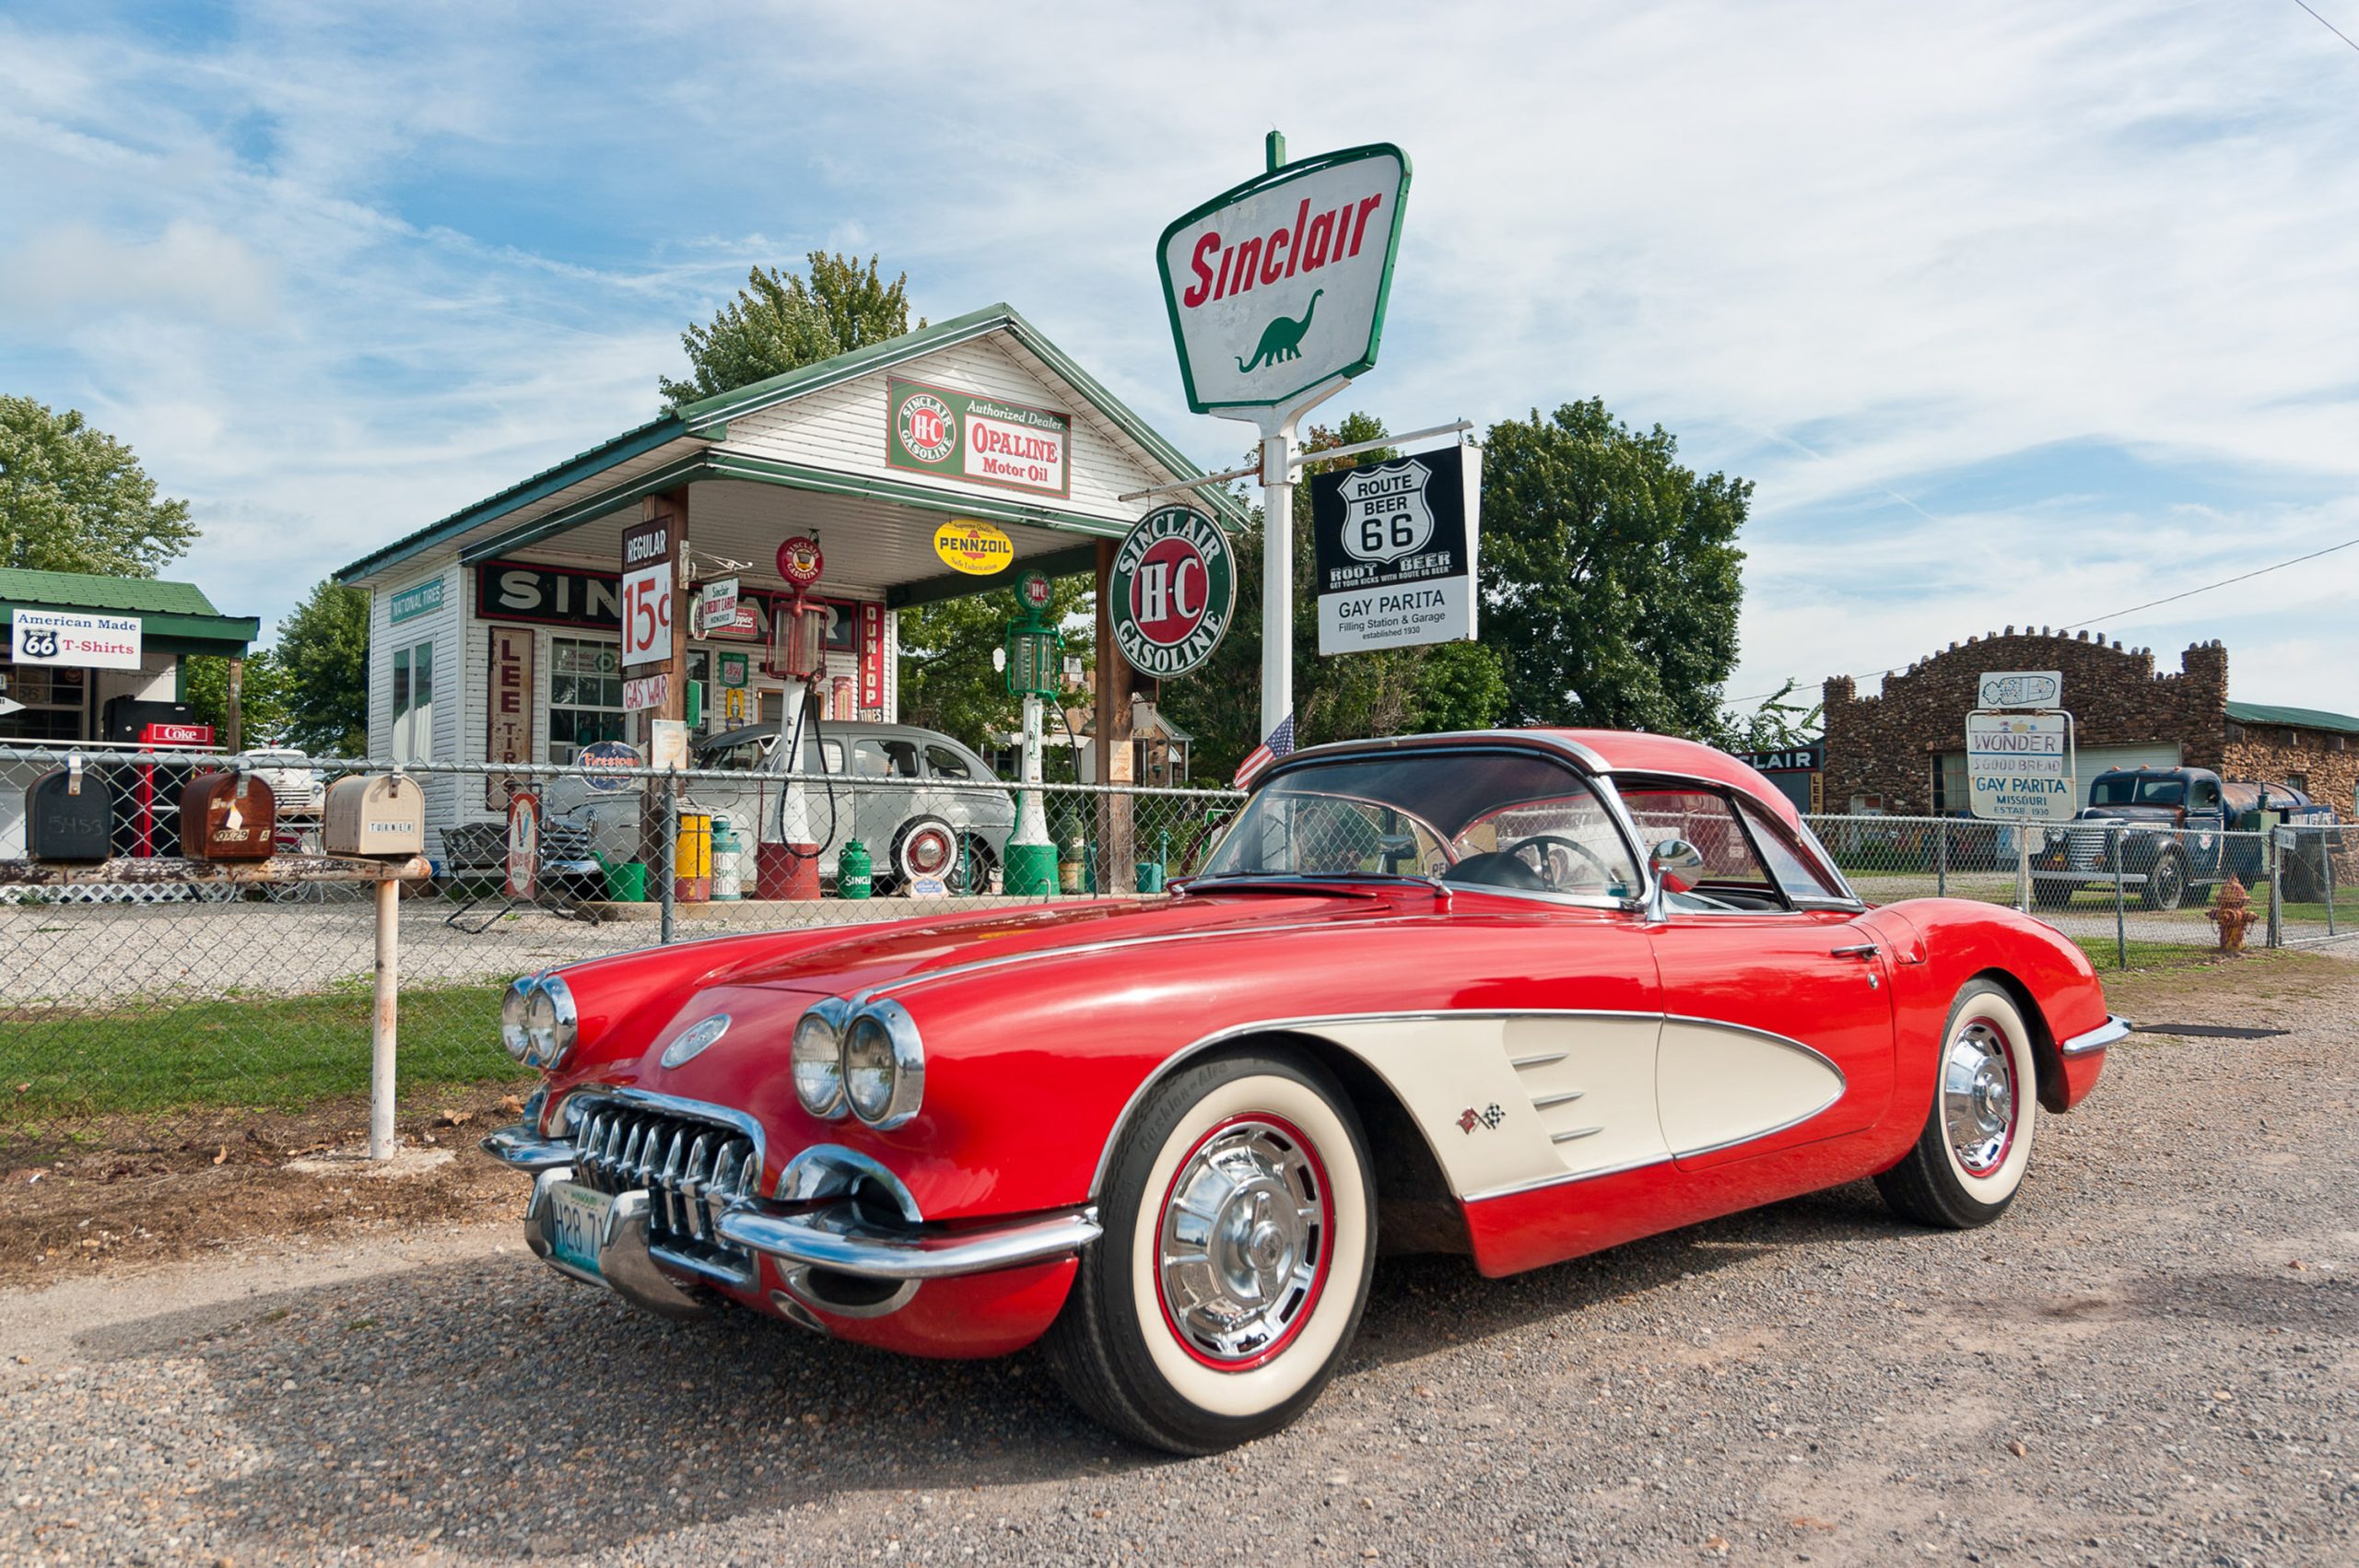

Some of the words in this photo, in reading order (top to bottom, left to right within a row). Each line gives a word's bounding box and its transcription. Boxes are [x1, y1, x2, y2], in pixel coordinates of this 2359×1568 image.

[1183, 193, 1382, 308] Sinclair
[902, 394, 953, 427] SINCLAIR
[967, 400, 1026, 424] Authorized
[1027, 412, 1062, 430] Dealer
[901, 428, 953, 460] GASOLINE
[972, 422, 1058, 464] OPALINE
[982, 457, 1026, 478] Motor
[1027, 465, 1049, 482] Oil
[1357, 474, 1413, 497] ROUTE
[1364, 497, 1408, 516] BEER
[1360, 513, 1414, 552] 66
[628, 529, 666, 564] REGULAR
[786, 542, 820, 559] SINCLAIR
[939, 537, 1010, 554] PENNZOIL
[1118, 512, 1221, 576] SINCLAIR
[786, 563, 819, 579] GASOLINE
[1330, 562, 1378, 581] ROOT
[1400, 551, 1451, 571] BEER
[1330, 581, 1342, 590] GET
[1343, 579, 1359, 588] YOUR
[1360, 576, 1379, 585] KICKS
[1380, 573, 1397, 581] WITH
[1399, 570, 1419, 579] ROUTE
[422, 585, 440, 606] TIRES
[705, 599, 721, 614] CREDIT
[722, 595, 736, 612] CARDS
[1338, 598, 1373, 618] GAY
[1379, 590, 1445, 614] PARITA
[18, 614, 92, 628] American
[98, 618, 136, 631] Made
[1339, 619, 1365, 632] Filling
[1367, 615, 1399, 630] Station
[1401, 614, 1409, 625] &
[1411, 611, 1446, 626] Garage
[1118, 610, 1224, 672] GASOLINE
[1362, 627, 1402, 639] established
[1403, 626, 1421, 635] 1930
[25, 636, 55, 655] 66
[63, 639, 135, 655] T-Shirts
[865, 606, 877, 704] DUNLOP
[500, 639, 521, 713] LEE
[625, 680, 644, 710] GAS
[646, 674, 668, 705] WAR
[860, 708, 882, 722] TIRES
[164, 726, 197, 740] Coke
[1974, 734, 2056, 752] WONDER
[581, 752, 640, 767] Firestone
[1982, 758, 2015, 770] GOOD
[2018, 759, 2060, 772] BREAD
[1976, 777, 2007, 792] GAY
[1996, 795, 2047, 806] MISSOURI
[2031, 808, 2049, 816] 1930
[370, 823, 411, 831] TURNER
